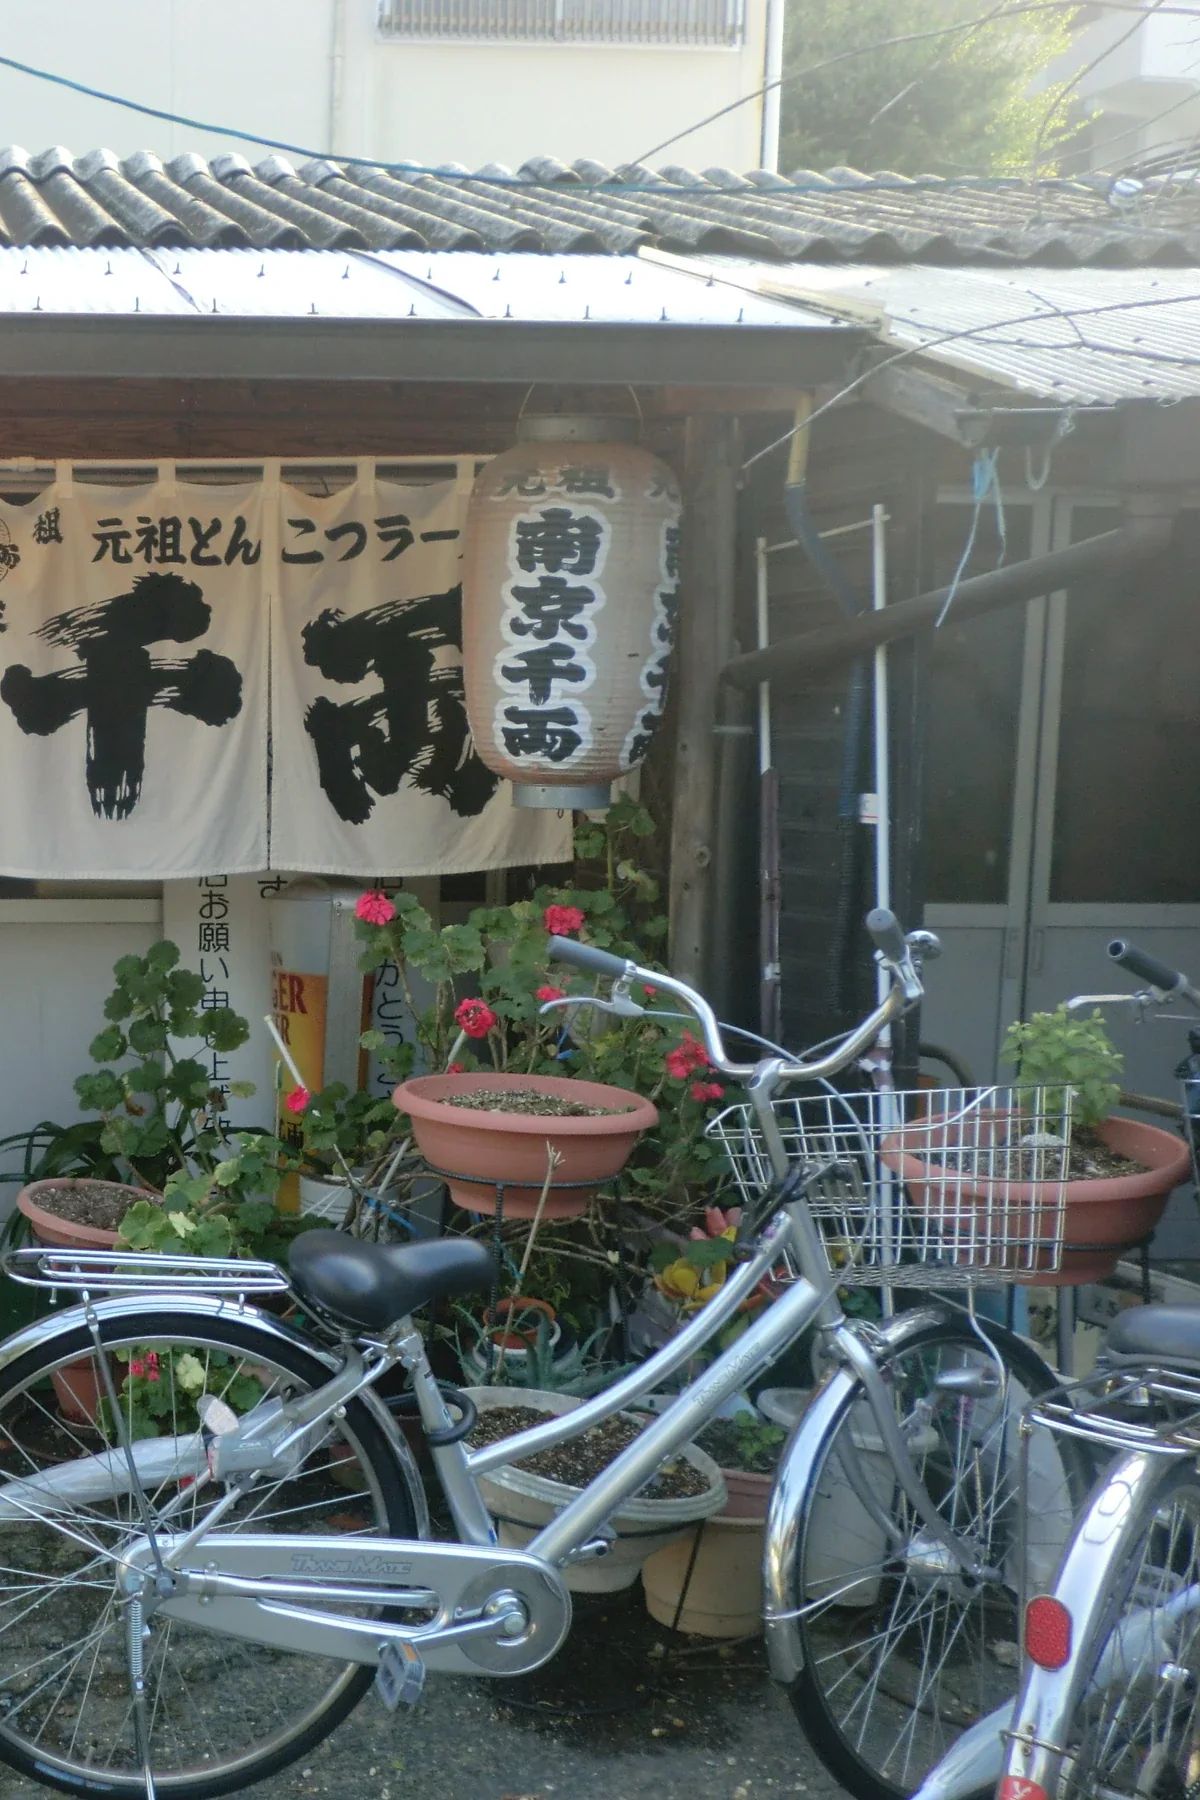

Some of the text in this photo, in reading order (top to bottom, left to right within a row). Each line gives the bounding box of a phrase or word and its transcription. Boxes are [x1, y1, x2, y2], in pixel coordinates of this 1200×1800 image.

[91, 511, 464, 566] 元祖とんこつラー
[500, 507, 603, 763] 南京千両
